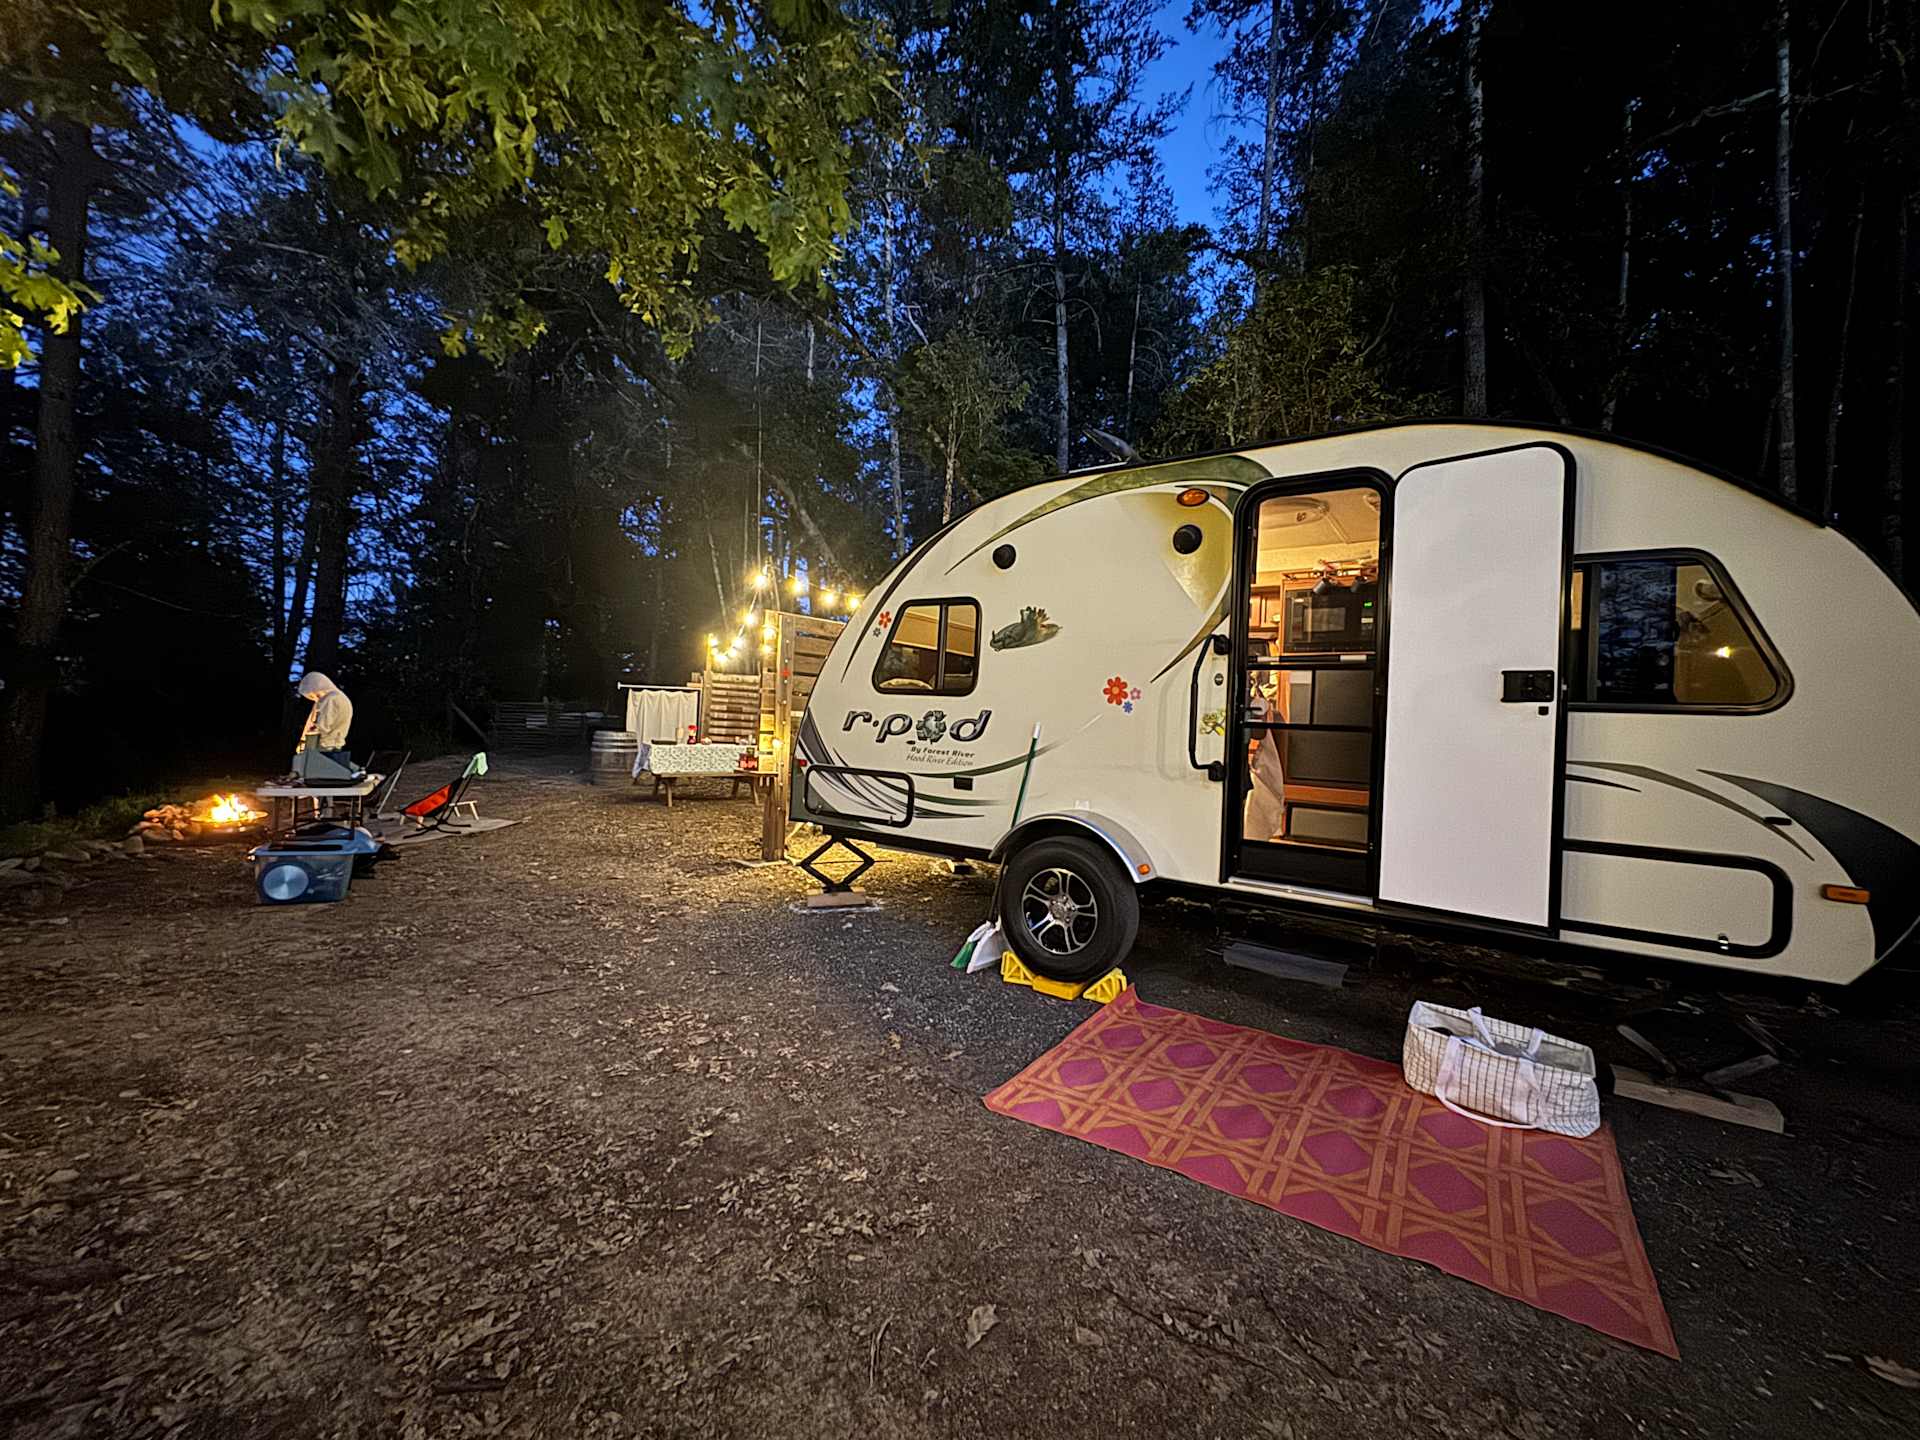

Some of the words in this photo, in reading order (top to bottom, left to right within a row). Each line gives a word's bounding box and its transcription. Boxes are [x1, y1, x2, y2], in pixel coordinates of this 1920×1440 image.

[911, 746, 920, 754] By
[922, 747, 950, 756] Forest
[951, 750, 976, 758] River
